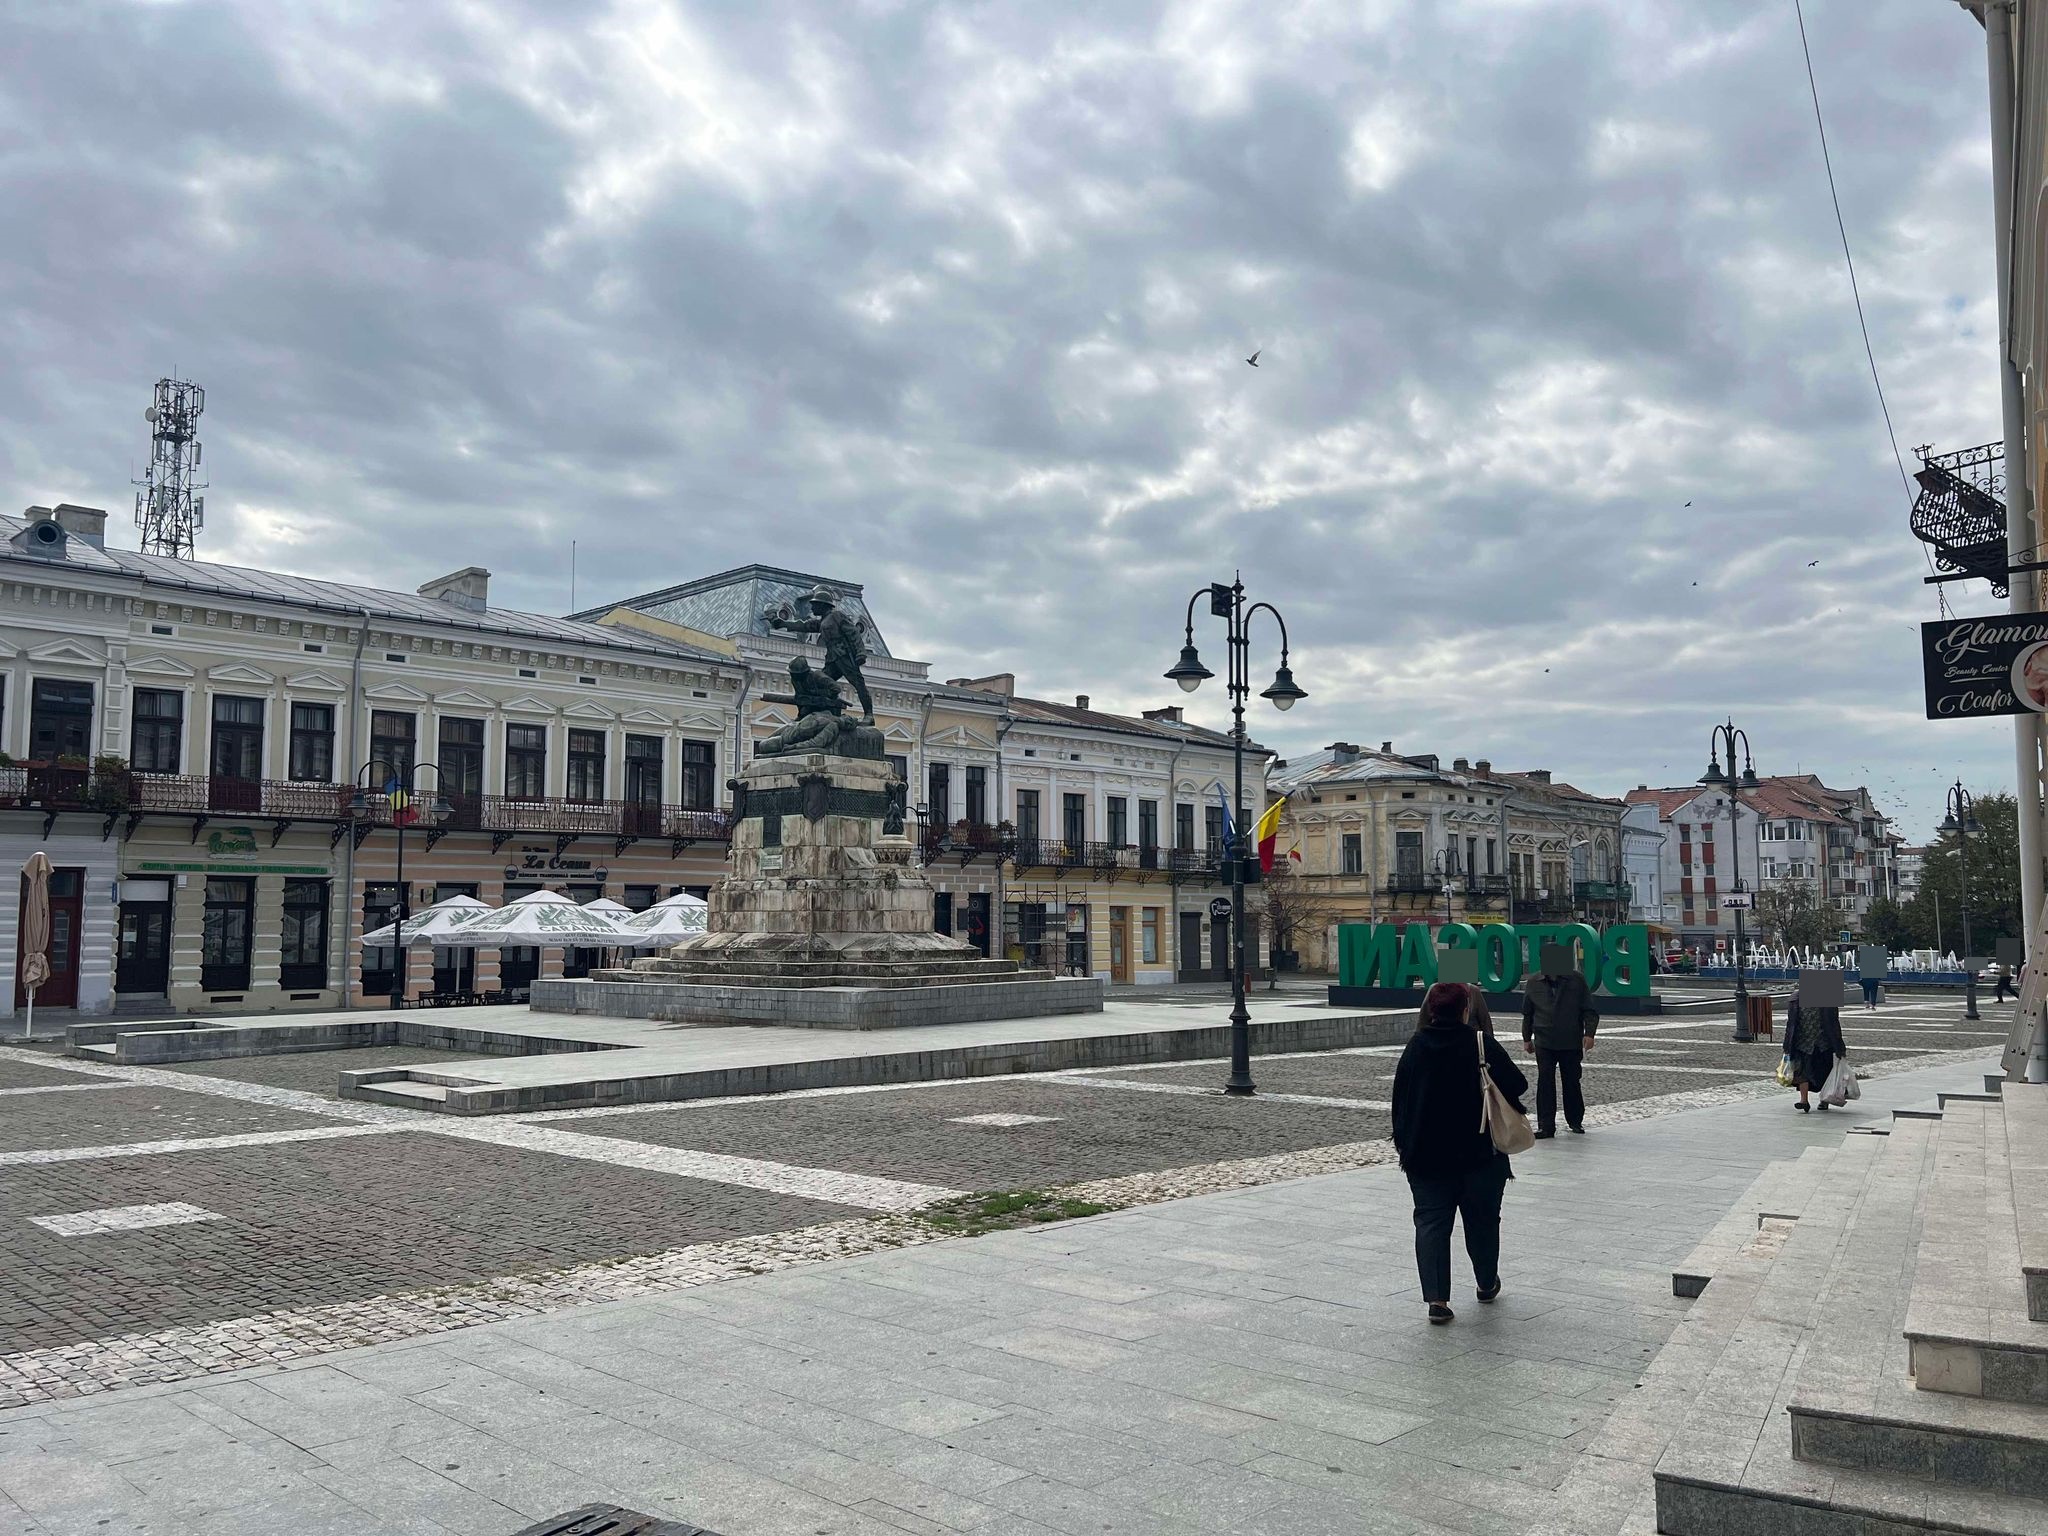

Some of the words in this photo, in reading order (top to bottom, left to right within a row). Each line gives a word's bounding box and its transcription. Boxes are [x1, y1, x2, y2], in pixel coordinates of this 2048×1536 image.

[1944, 666, 1979, 678] Beauty
[1982, 664, 2009, 675] Center
[1936, 689, 2015, 714] Coafor
[522, 855, 545, 869] La
[538, 923, 620, 934] CARAIMAN
